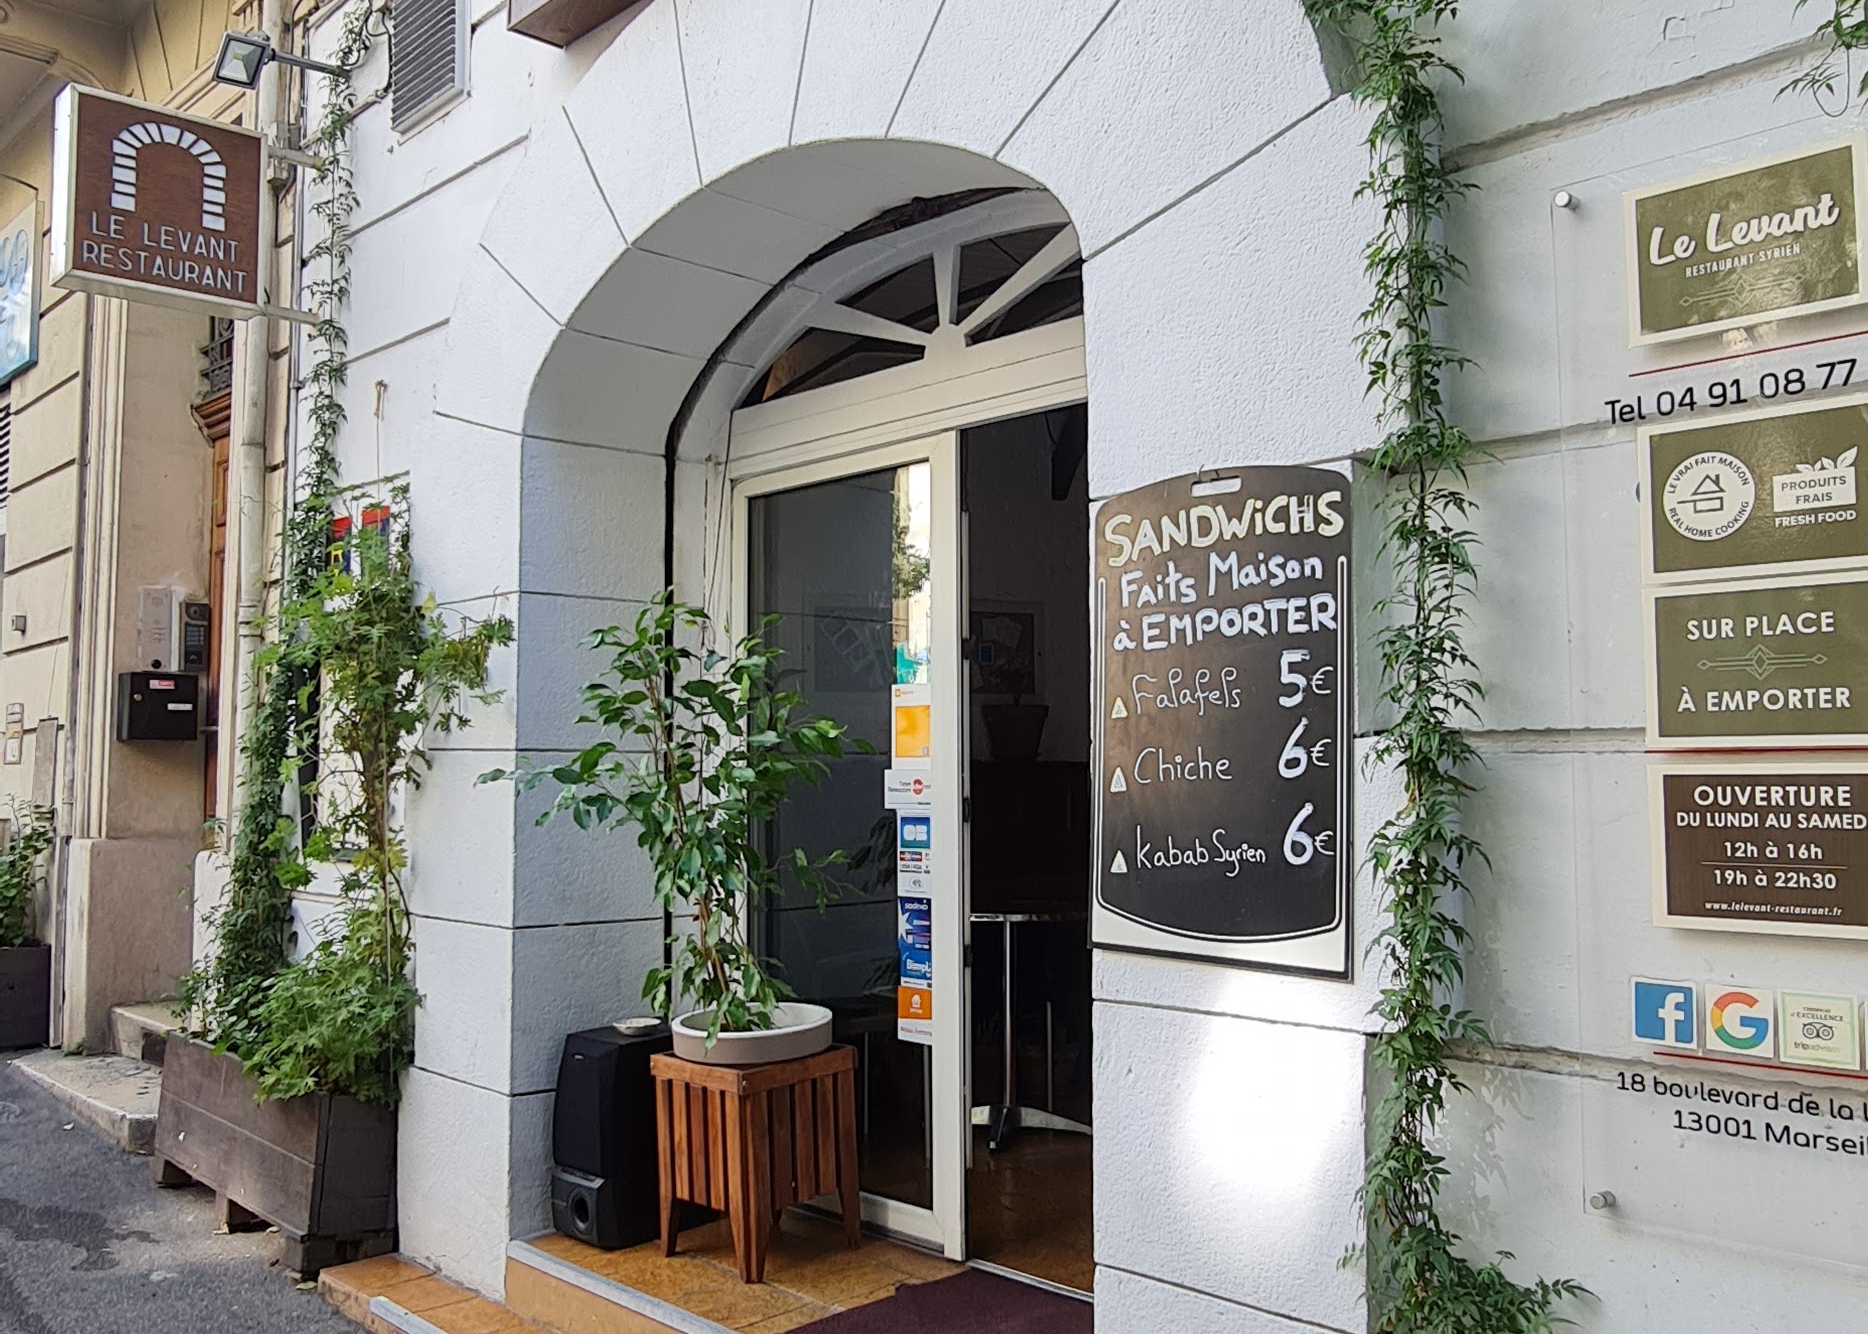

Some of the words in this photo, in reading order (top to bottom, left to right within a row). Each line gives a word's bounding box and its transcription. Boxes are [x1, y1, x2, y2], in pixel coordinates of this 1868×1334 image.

[91, 210, 126, 239] LE
[142, 222, 240, 264] LEVANT
[1649, 226, 1695, 267] Le
[1705, 192, 1840, 254] Levant
[83, 240, 249, 294] RESTAURANT
[1685, 253, 1755, 278] RESTAURANT
[1759, 243, 1801, 262] SYRIEN
[1604, 396, 1647, 425] Tel
[1656, 387, 1697, 416] 04
[1708, 379, 1749, 408] 91
[1759, 369, 1806, 399] 08
[1815, 358, 1858, 391] 77
[1667, 482, 1677, 495] LE
[1674, 462, 1694, 483] VRAI
[1695, 455, 1717, 467] FAIT
[1718, 457, 1750, 487] MAISON
[1781, 475, 1847, 492] PRODUITS
[1795, 492, 1833, 505] FRAIS
[1668, 507, 1684, 529] REAL
[1684, 526, 1713, 538] HOME
[1715, 501, 1749, 536] COOKING
[1774, 514, 1816, 528] FRESH
[1818, 509, 1857, 524] FOOD
[1207, 550, 1324, 597] Maison
[1113, 619, 1137, 652] à
[1142, 593, 1338, 651] EMPORTER
[1686, 617, 1735, 641] SUR
[1745, 611, 1835, 637] PLACE
[1131, 666, 1242, 716] Falafels
[1677, 686, 1696, 713] À
[1706, 686, 1851, 712] EMPORTER
[1133, 746, 1234, 786] Chiche
[1693, 784, 1852, 808] OUVERTURE
[1676, 812, 1701, 828] DU
[1705, 812, 1760, 829] LUNDI
[1764, 812, 1793, 829] AU
[1212, 828, 1267, 878] Syrien
[1723, 841, 1759, 859] 12h
[1765, 841, 1779, 859] à
[1786, 842, 1824, 860] 16h
[1713, 869, 1748, 886] 19h
[1755, 869, 1768, 887] à
[1774, 871, 1837, 889] 22h30
[1710, 991, 1769, 1050] G
[1796, 1011, 1844, 1022] EXCELLENCE
[1616, 1072, 1646, 1092] 18
[1653, 1076, 1779, 1111] boulevard
[1788, 1092, 1820, 1116] de
[1829, 1098, 1854, 1121] la
[1673, 1110, 1757, 1141] 13001
